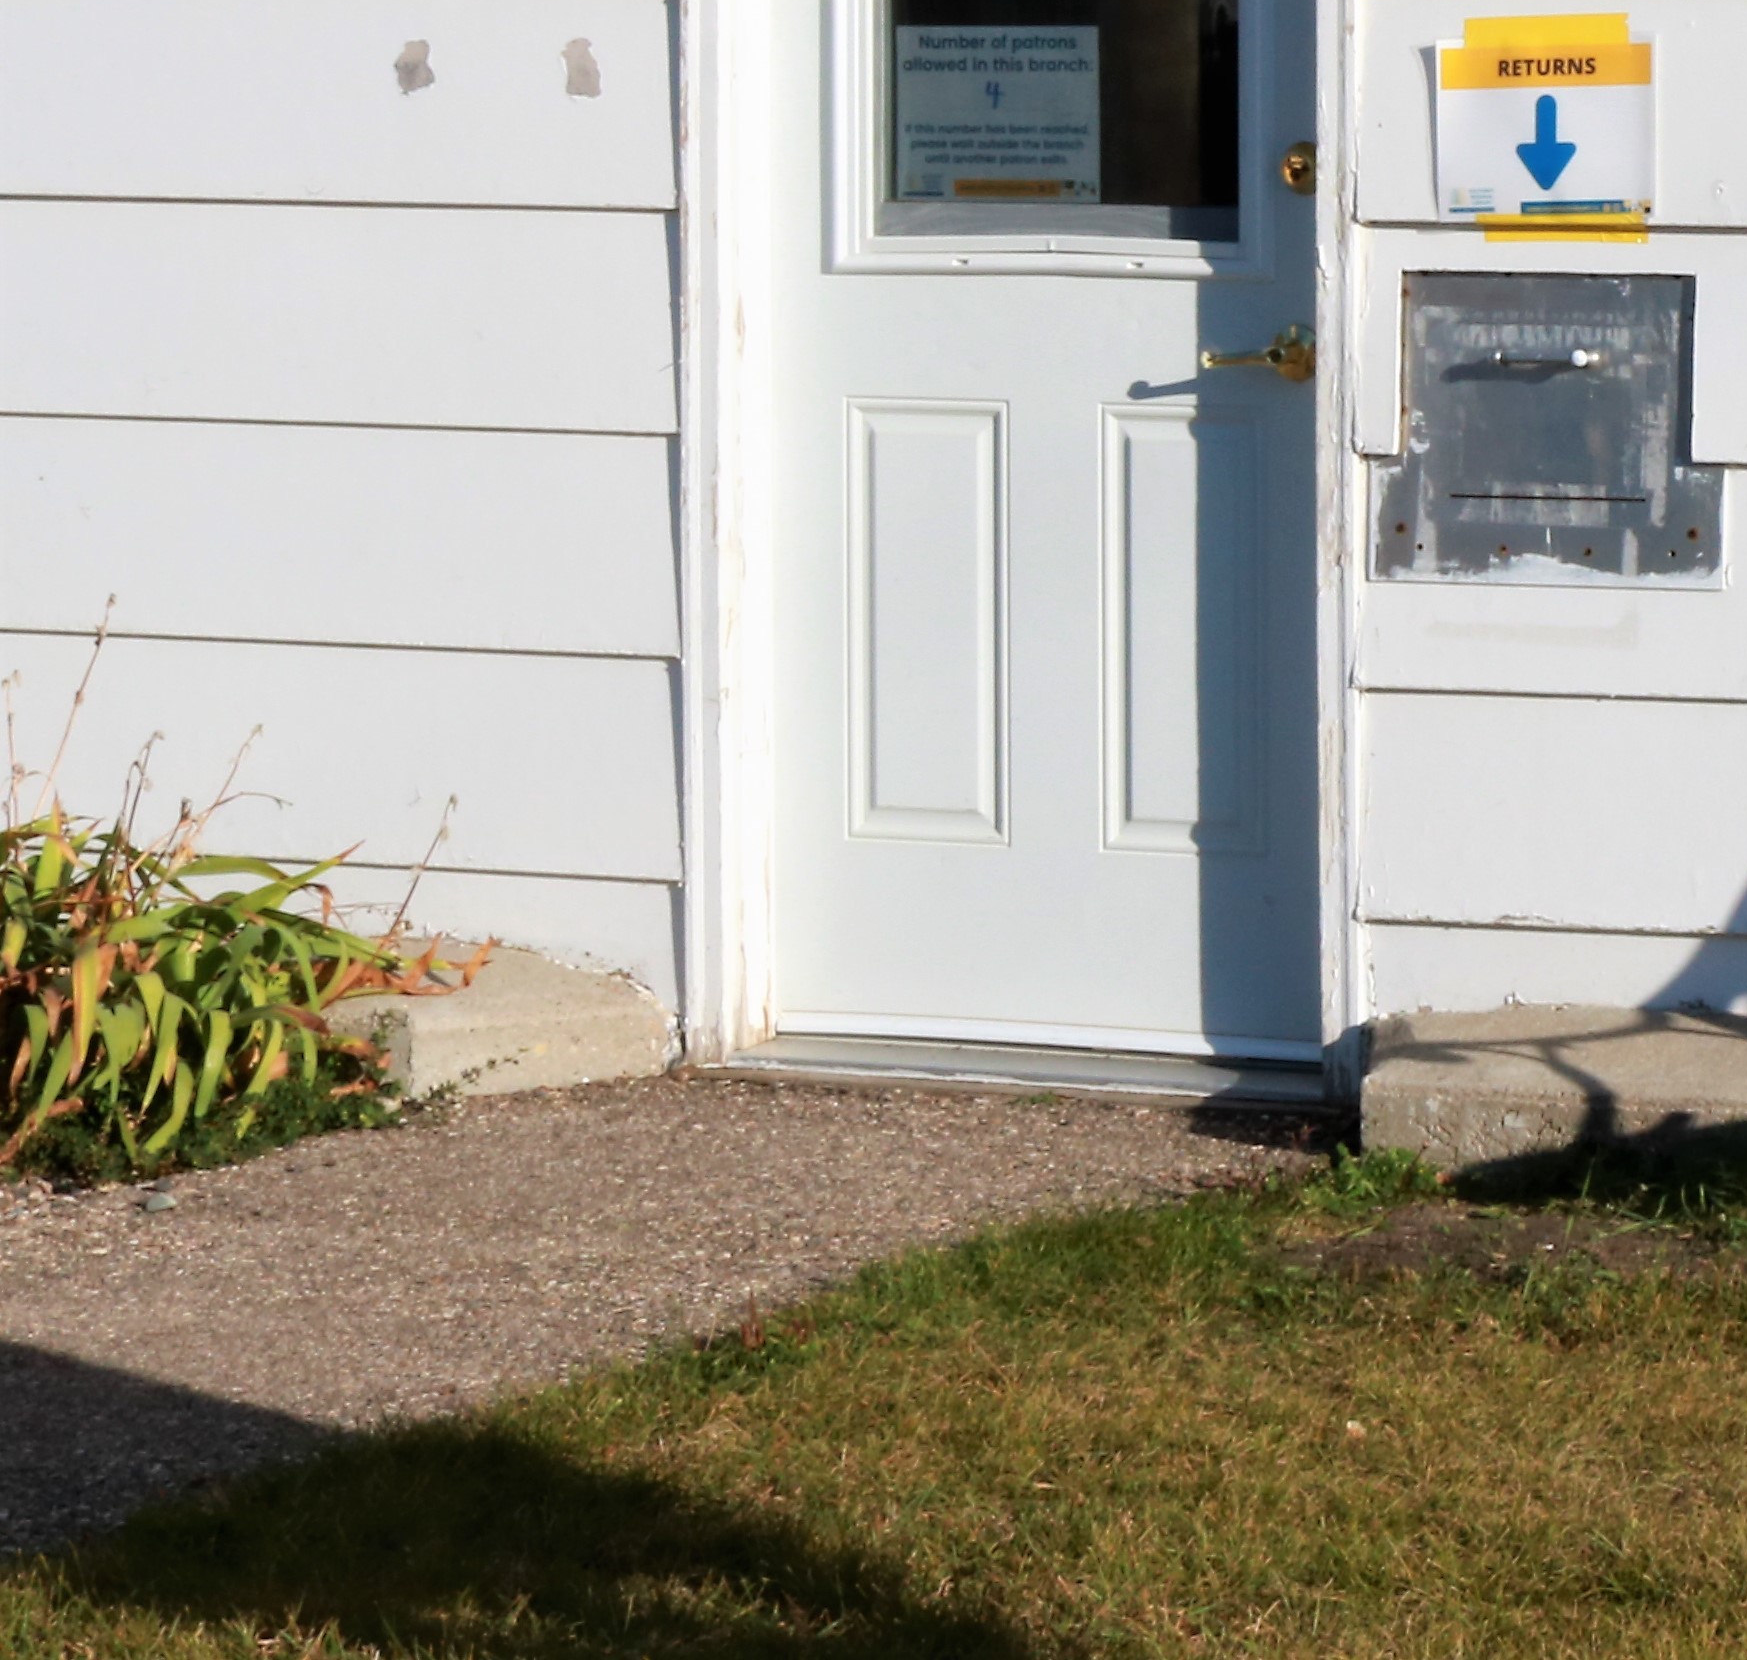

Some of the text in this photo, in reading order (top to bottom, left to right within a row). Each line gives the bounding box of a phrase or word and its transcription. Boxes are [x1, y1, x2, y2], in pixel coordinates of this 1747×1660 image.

[918, 34, 1077, 54] Number of patrons
[903, 57, 967, 72] allowed
[972, 57, 988, 72] in
[993, 57, 1023, 72] this
[1498, 57, 1596, 77] RETURNS
[985, 80, 1005, 109] 4
